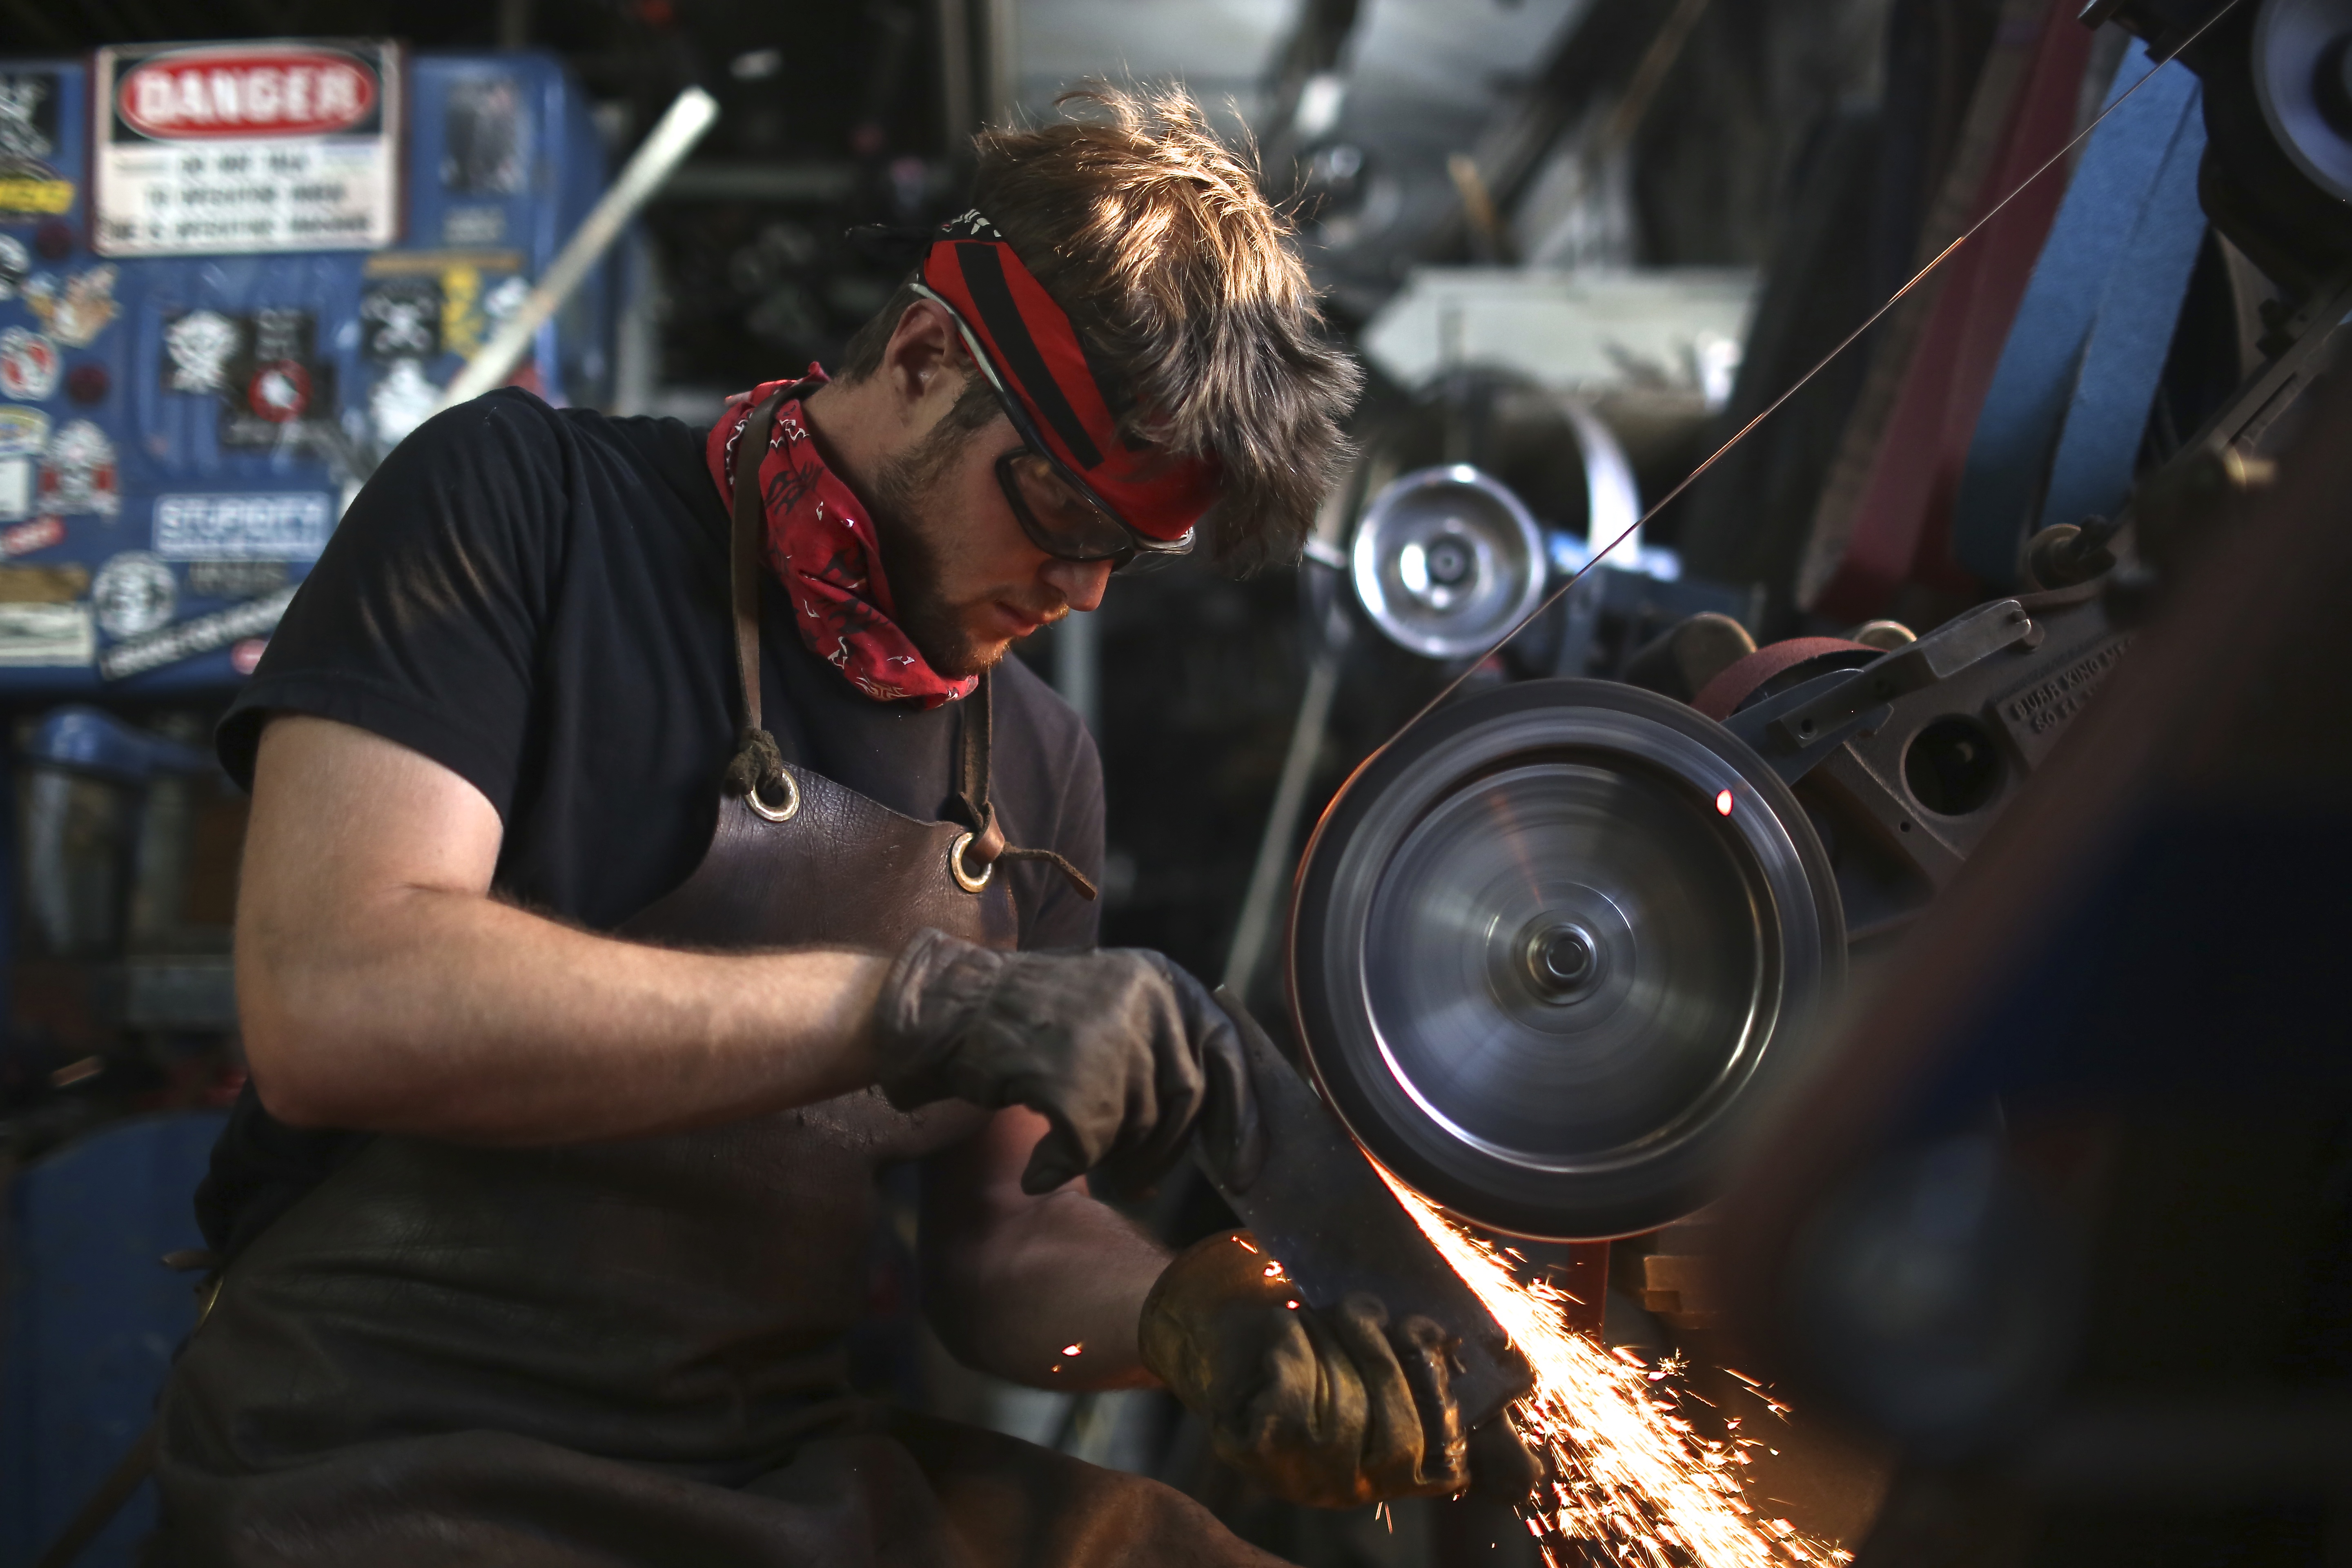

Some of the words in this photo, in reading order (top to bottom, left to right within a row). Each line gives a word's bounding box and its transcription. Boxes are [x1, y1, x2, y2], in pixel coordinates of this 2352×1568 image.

[133, 65, 361, 125] DANGER
[2011, 682, 2062, 720] BURR
[2062, 659, 2100, 690] KING
